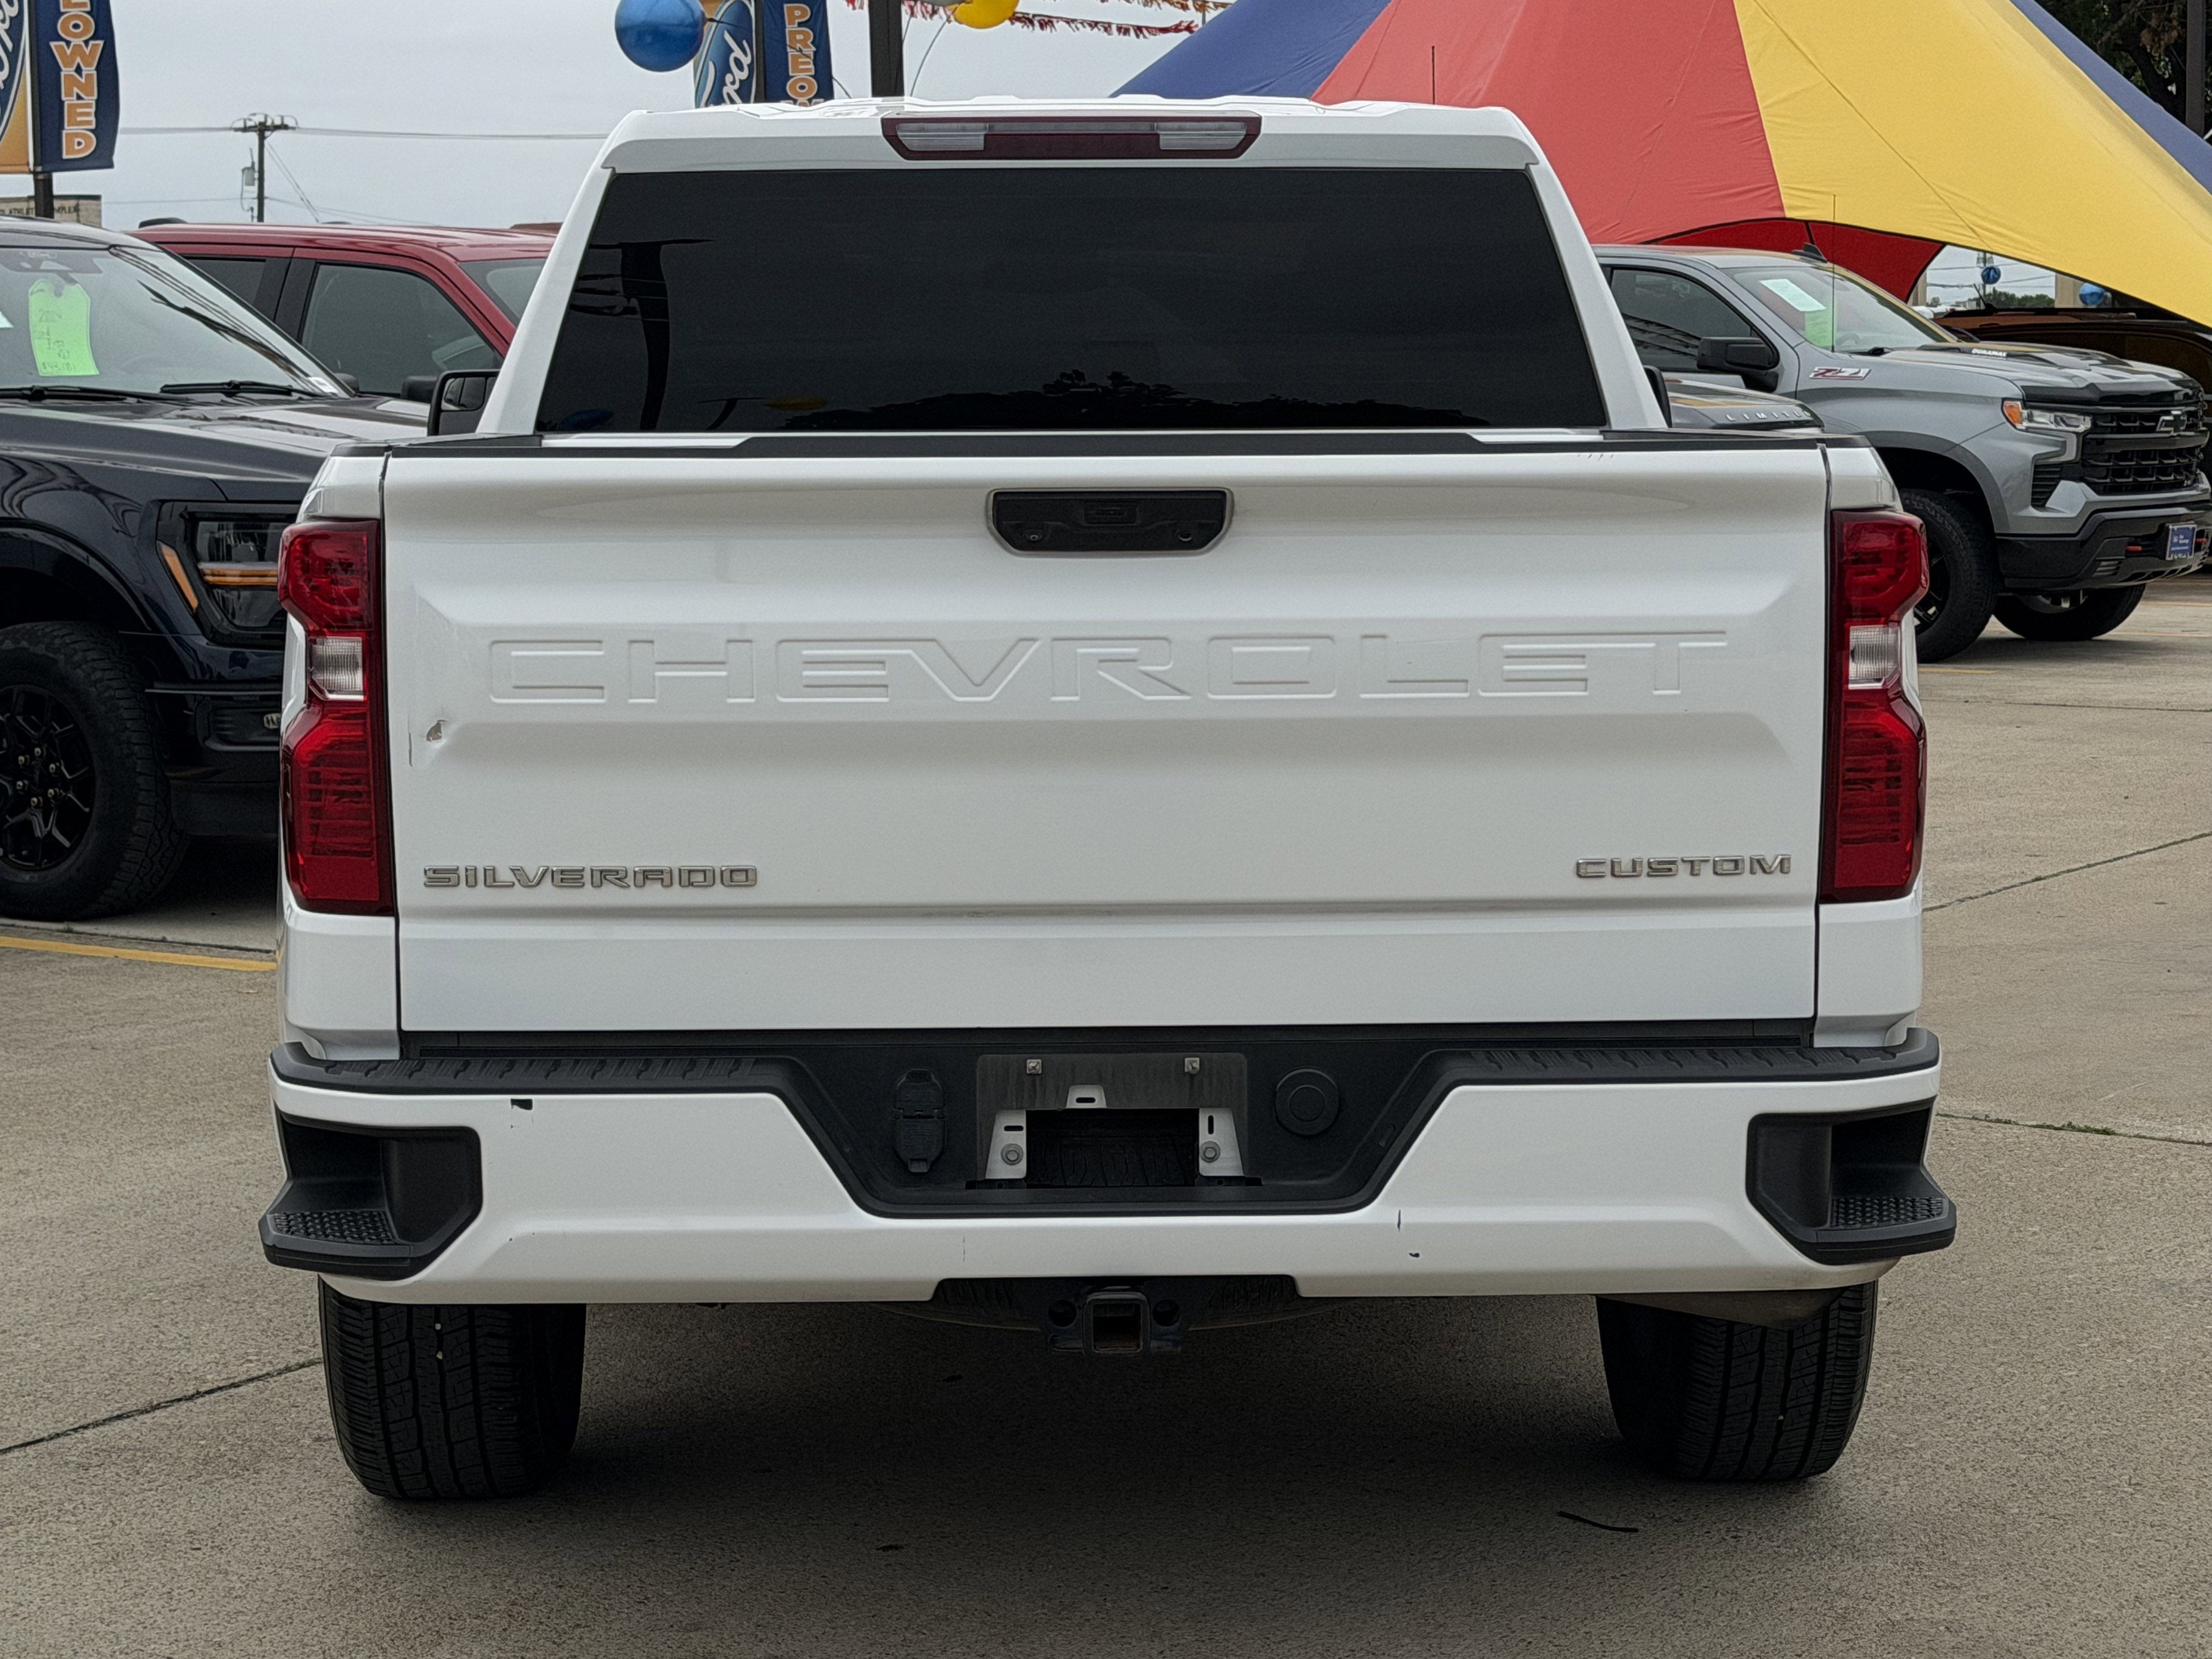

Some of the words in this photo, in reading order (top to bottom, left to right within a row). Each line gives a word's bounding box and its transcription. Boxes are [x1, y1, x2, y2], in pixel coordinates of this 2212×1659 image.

[783, 3, 825, 107] PREO
[1809, 366, 1871, 380] Z71
[489, 630, 1728, 703] CHEVROLET
[423, 865, 758, 888] SILVERADO
[1576, 854, 1792, 878] CUSTOM
